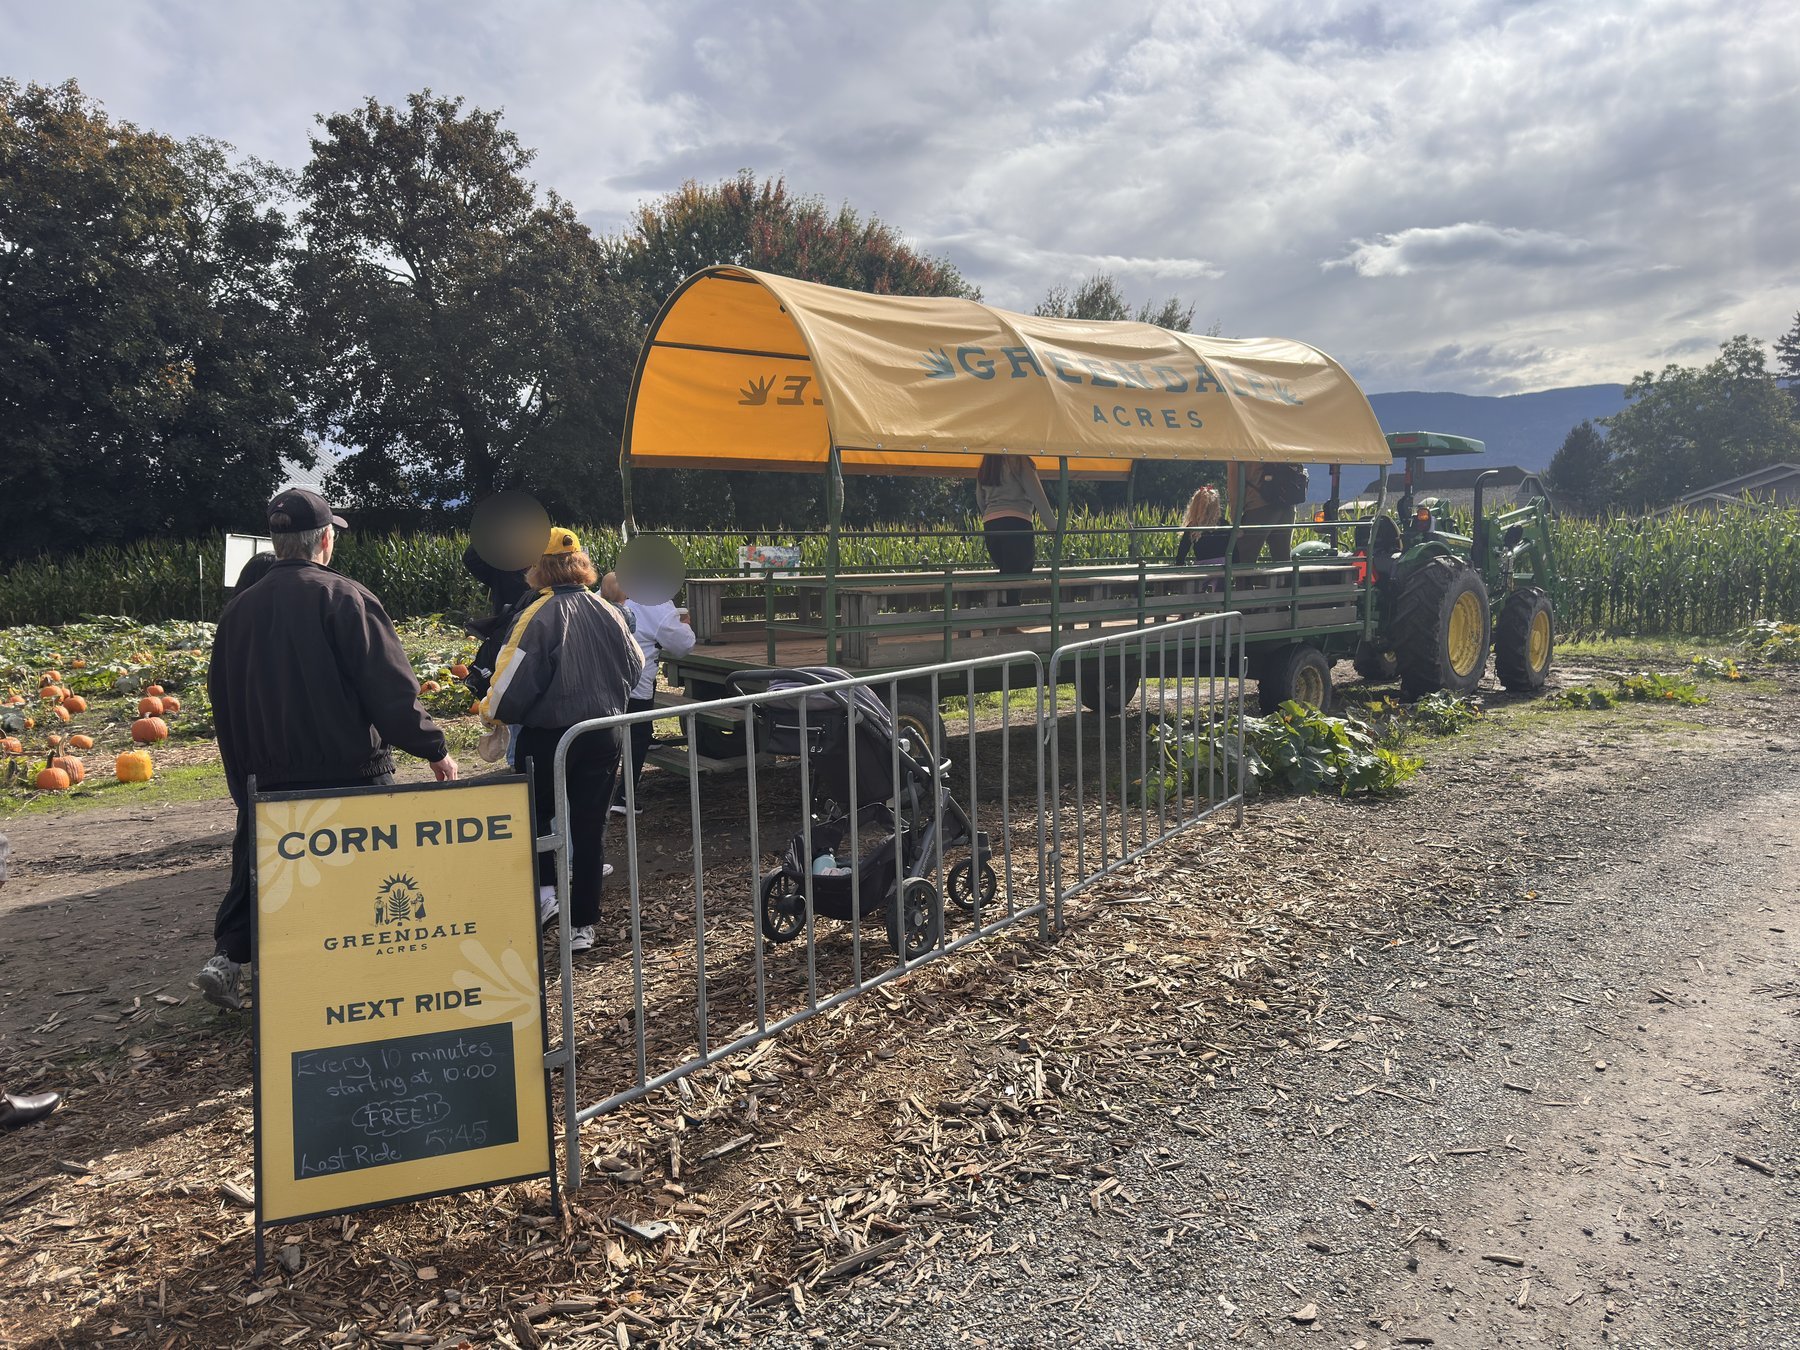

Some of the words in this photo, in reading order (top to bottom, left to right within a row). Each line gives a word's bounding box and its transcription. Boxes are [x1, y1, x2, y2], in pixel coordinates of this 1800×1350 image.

[1093, 404, 1203, 429] ACRES
[277, 824, 398, 860] CORN
[415, 814, 513, 847] RIDE
[323, 921, 477, 951] GREENDALE
[375, 943, 428, 956] ACRES
[326, 997, 405, 1025] NEXT
[415, 987, 482, 1014] RIDE
[297, 1052, 372, 1079] Every
[382, 1049, 401, 1070] 10
[411, 1037, 493, 1063] minutes
[326, 1074, 407, 1096] starting
[410, 1068, 432, 1084] at
[443, 1063, 497, 1081] 10:00
[364, 1103, 438, 1128] FREE!!
[301, 1147, 351, 1177] Last
[351, 1142, 403, 1164] Ride
